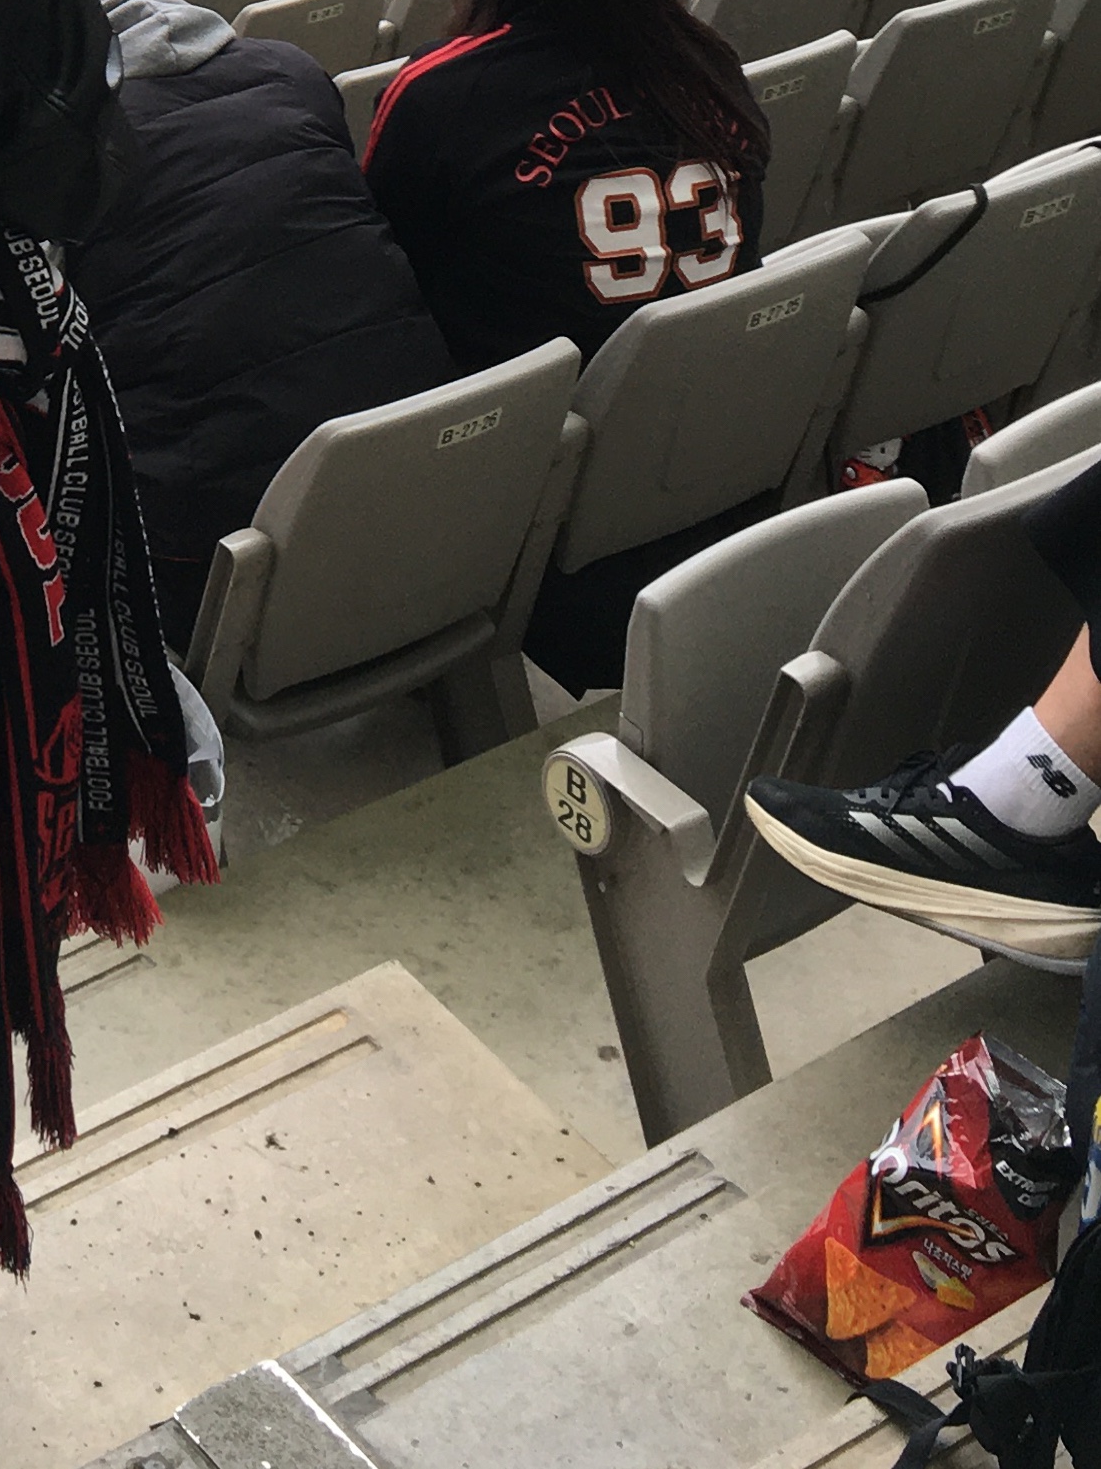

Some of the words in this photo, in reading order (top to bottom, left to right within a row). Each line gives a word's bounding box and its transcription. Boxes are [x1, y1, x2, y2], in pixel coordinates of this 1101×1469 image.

[514, 86, 633, 188] SEOUL
[574, 158, 744, 305] 93
[17, 254, 61, 330] SEOUL
[440, 410, 499, 445] B-27-26
[57, 469, 88, 527] CLUB
[73, 608, 101, 669] SEOUL
[113, 598, 140, 658] CLUB
[79, 669, 106, 725] CLUB
[124, 657, 159, 719] SEOUL
[86, 726, 113, 813] FOOTBALL
[565, 766, 587, 806] B
[556, 799, 593, 844] 28
[870, 1120, 1017, 1264] oritos
